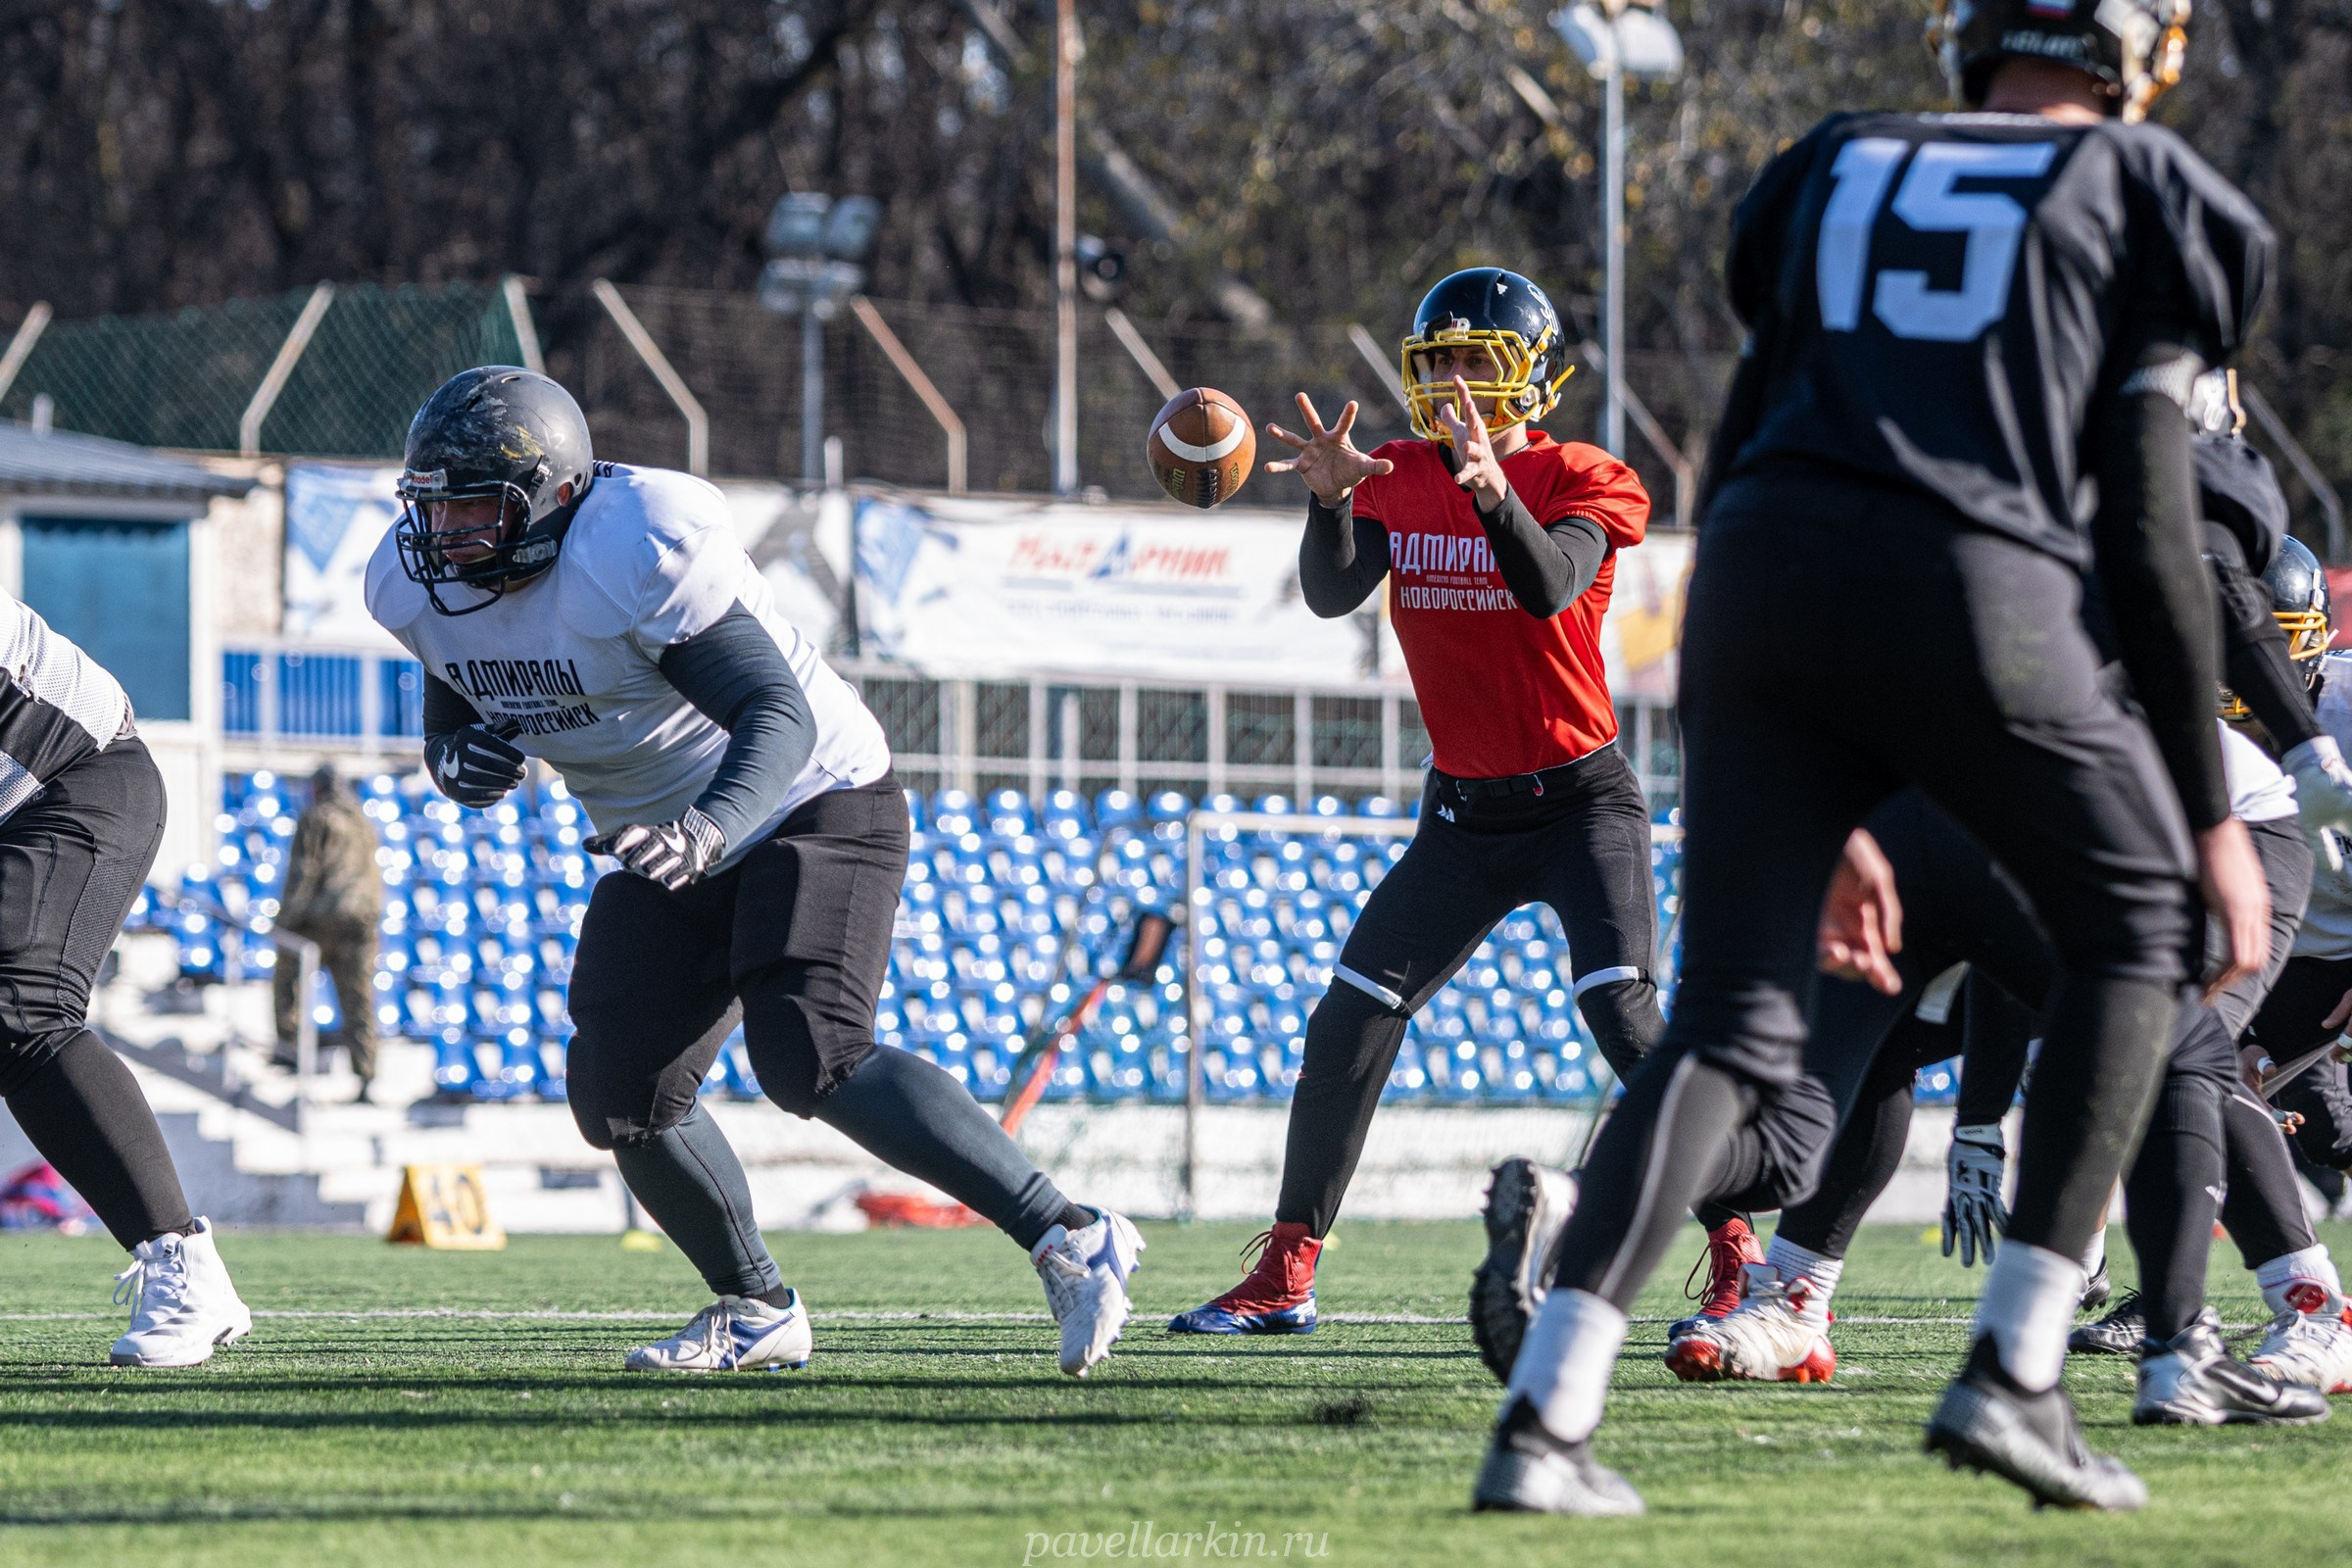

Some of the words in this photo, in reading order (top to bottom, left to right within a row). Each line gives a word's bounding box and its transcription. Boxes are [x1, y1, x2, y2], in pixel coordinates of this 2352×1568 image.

[1816, 136, 2057, 342] 15
[1390, 531, 1499, 575] АДМИРА
[1400, 584, 1518, 612] НОВОРОССИЙСК
[445, 659, 586, 702] АДМИРАЛЫ
